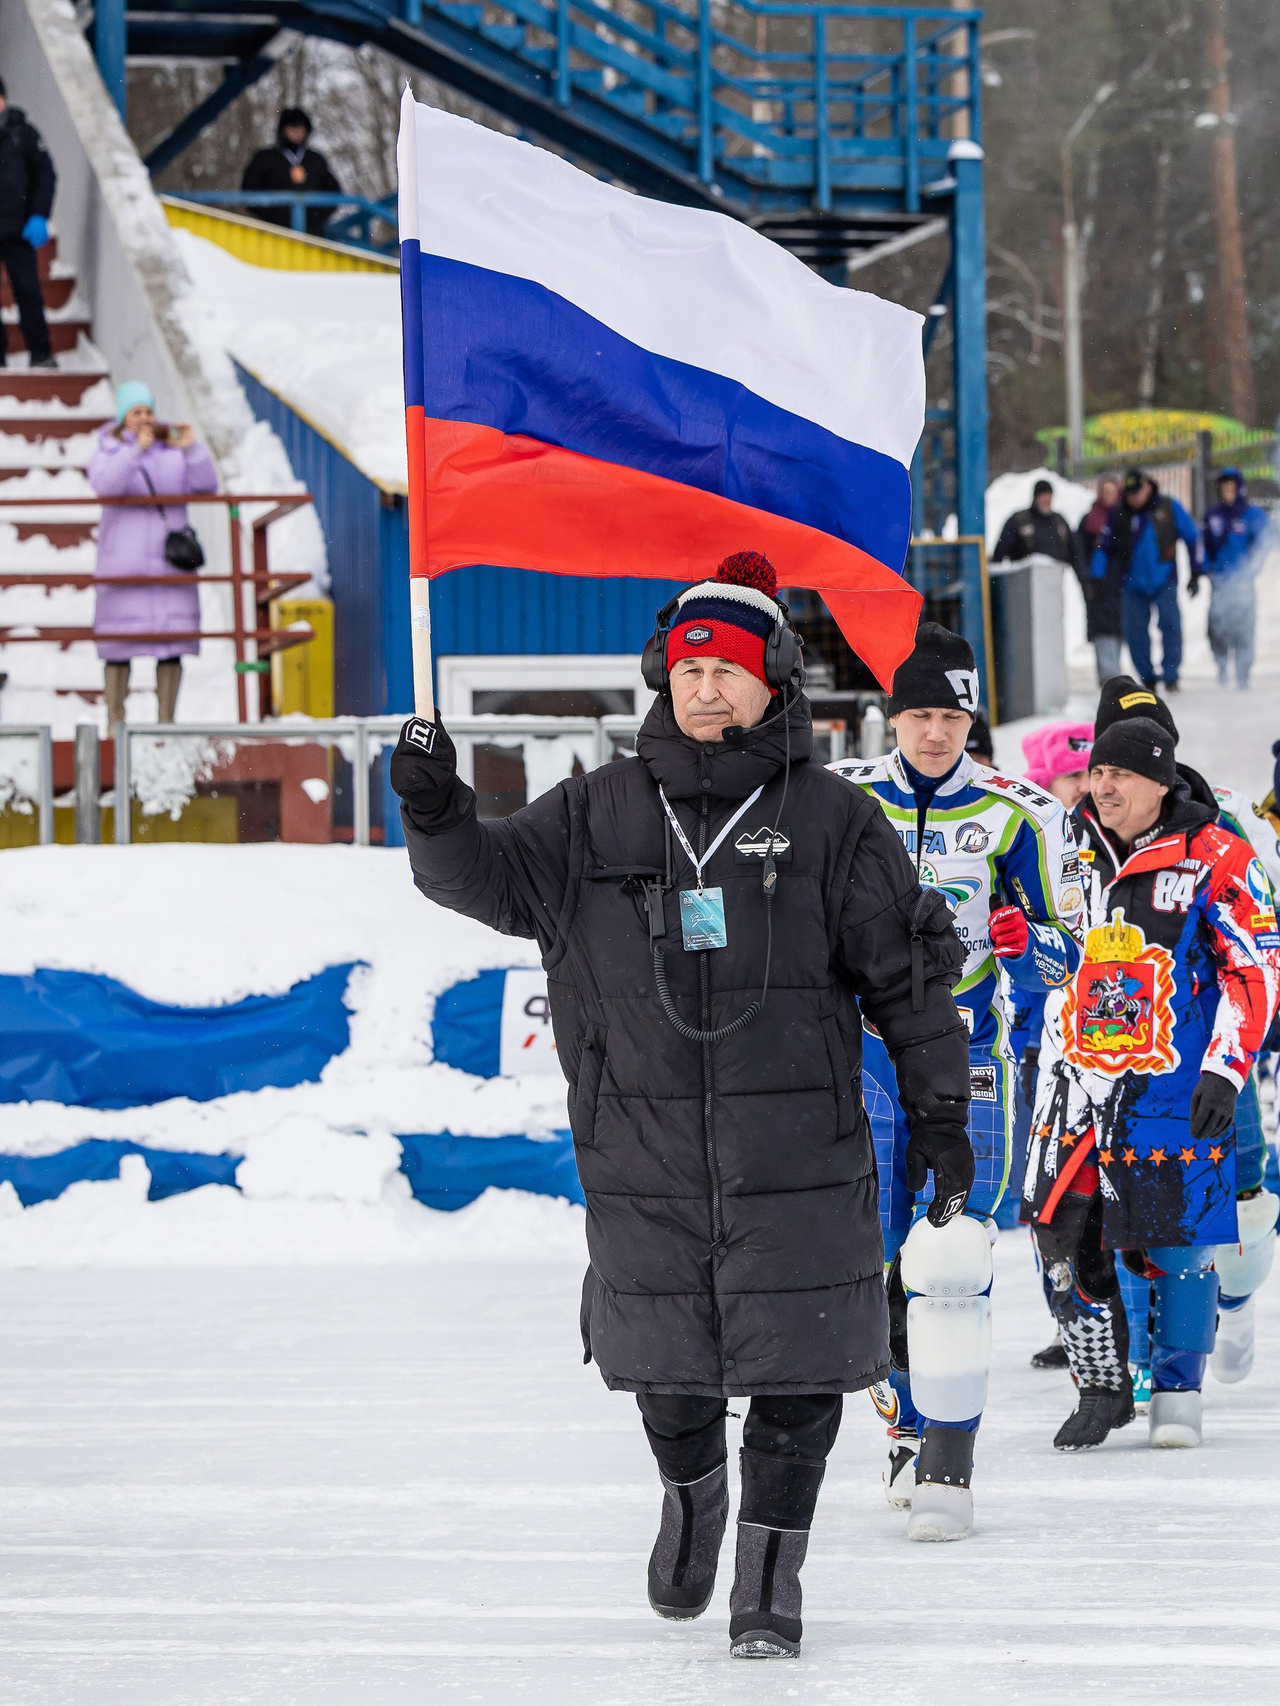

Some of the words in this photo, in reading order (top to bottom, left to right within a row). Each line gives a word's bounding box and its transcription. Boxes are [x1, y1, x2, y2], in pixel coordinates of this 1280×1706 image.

[898, 829, 948, 856] UFA
[1151, 869, 1197, 914] 84
[1026, 921, 1067, 954] UFA
